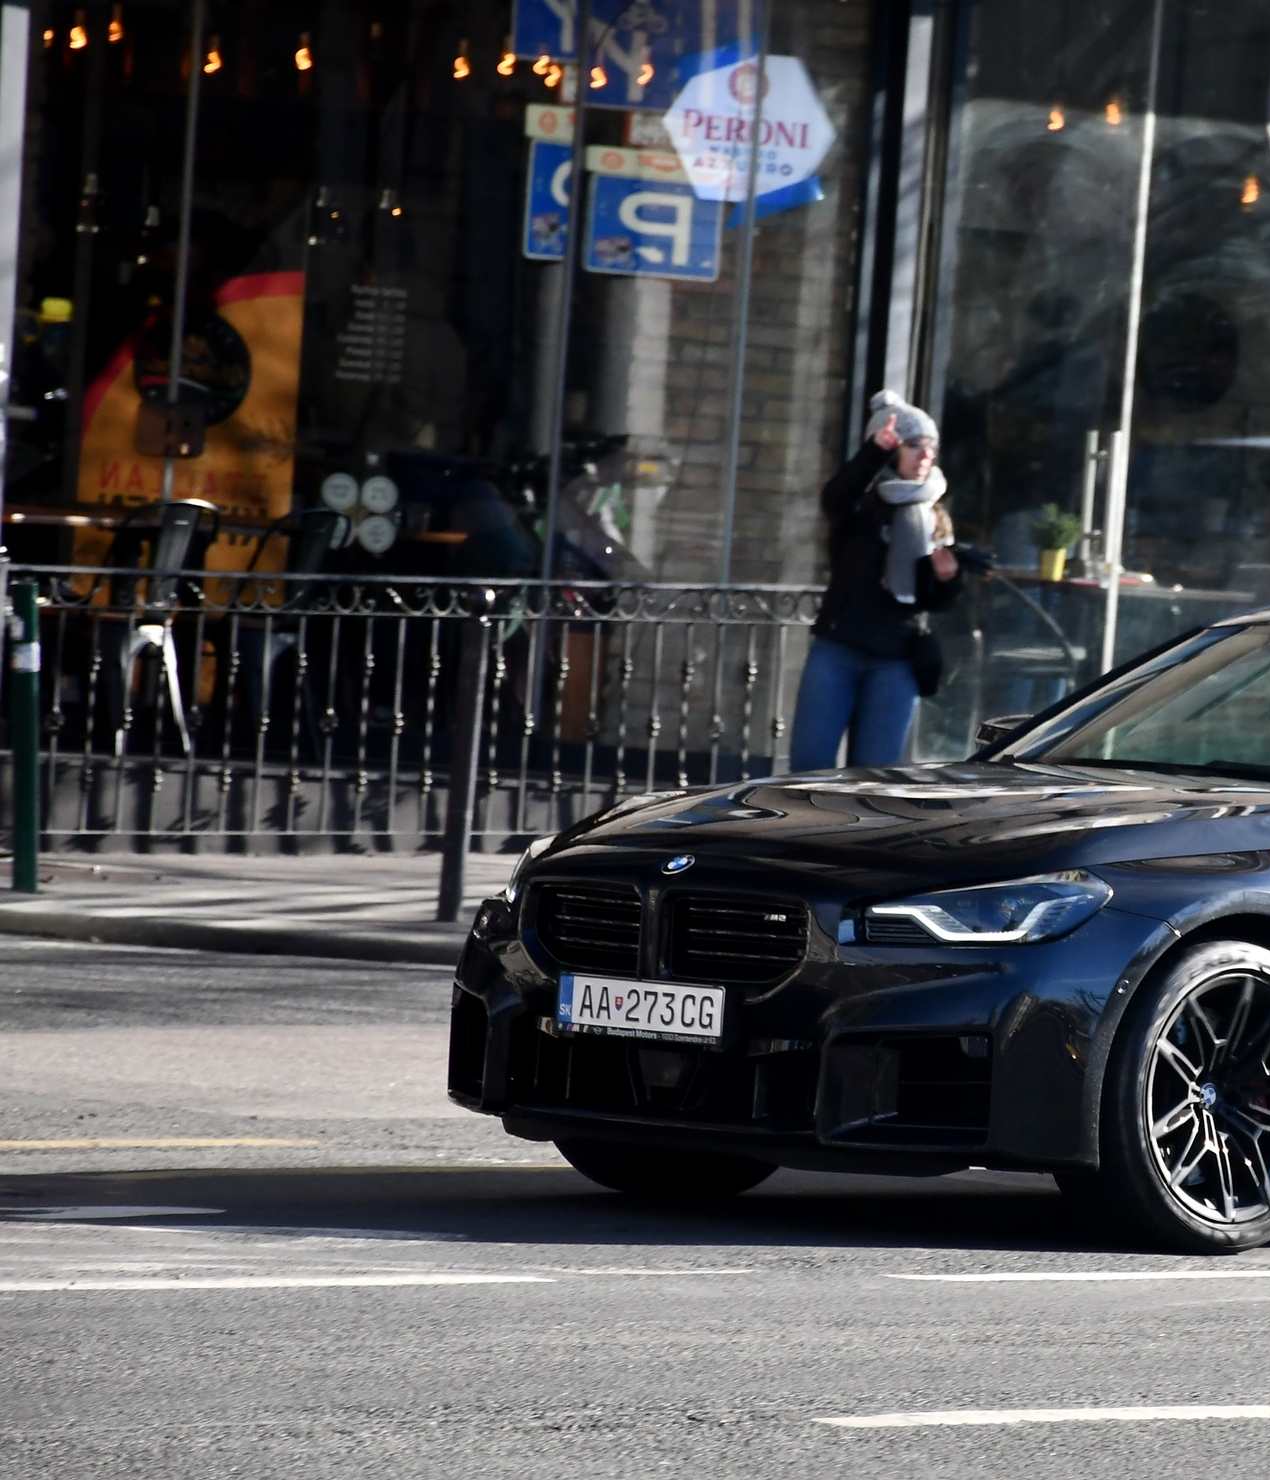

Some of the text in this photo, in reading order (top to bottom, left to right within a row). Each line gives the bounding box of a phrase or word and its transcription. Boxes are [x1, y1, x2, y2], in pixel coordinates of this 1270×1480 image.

[682, 109, 810, 149] PERONI
[559, 1004, 571, 1016] SK
[607, 1027, 635, 1038] Budapest
[636, 1030, 657, 1039] Motors
